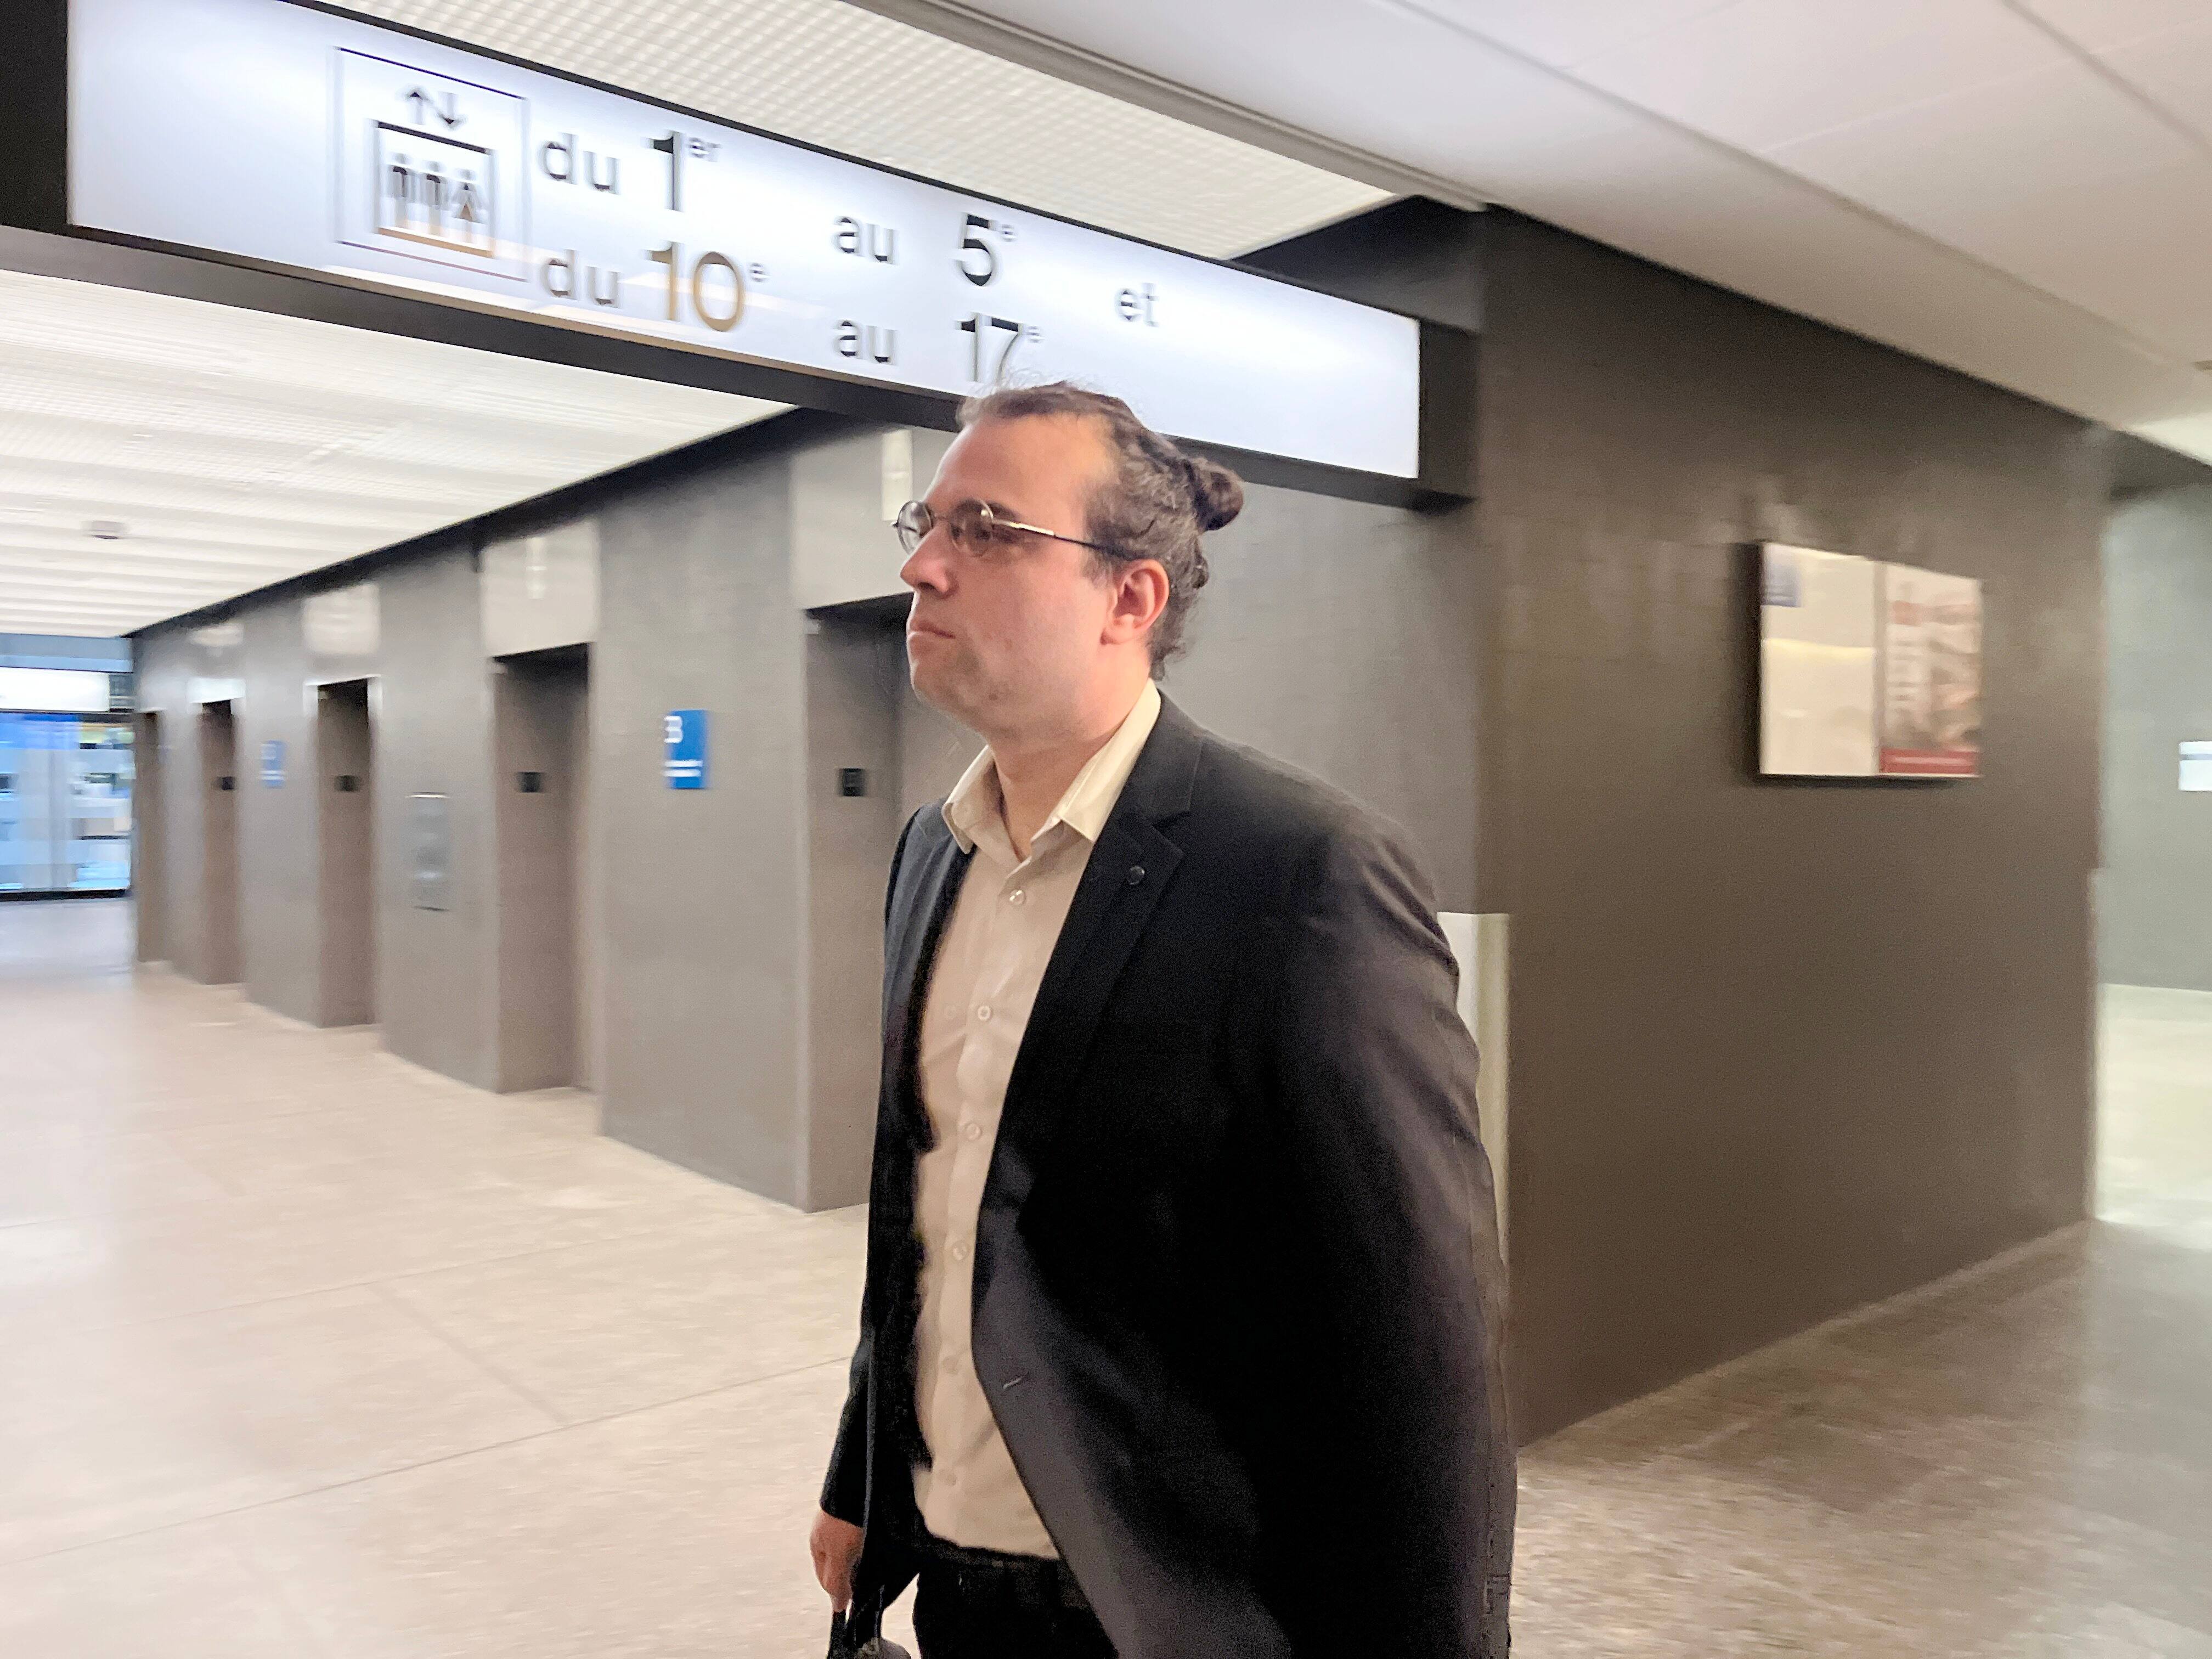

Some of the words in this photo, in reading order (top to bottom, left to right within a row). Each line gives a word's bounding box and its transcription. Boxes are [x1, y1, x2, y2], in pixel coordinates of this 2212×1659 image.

[539, 133, 619, 194] du
[834, 216, 898, 264] au
[1118, 283, 1158, 326] et
[540, 249, 620, 308] du
[834, 320, 898, 364] au
